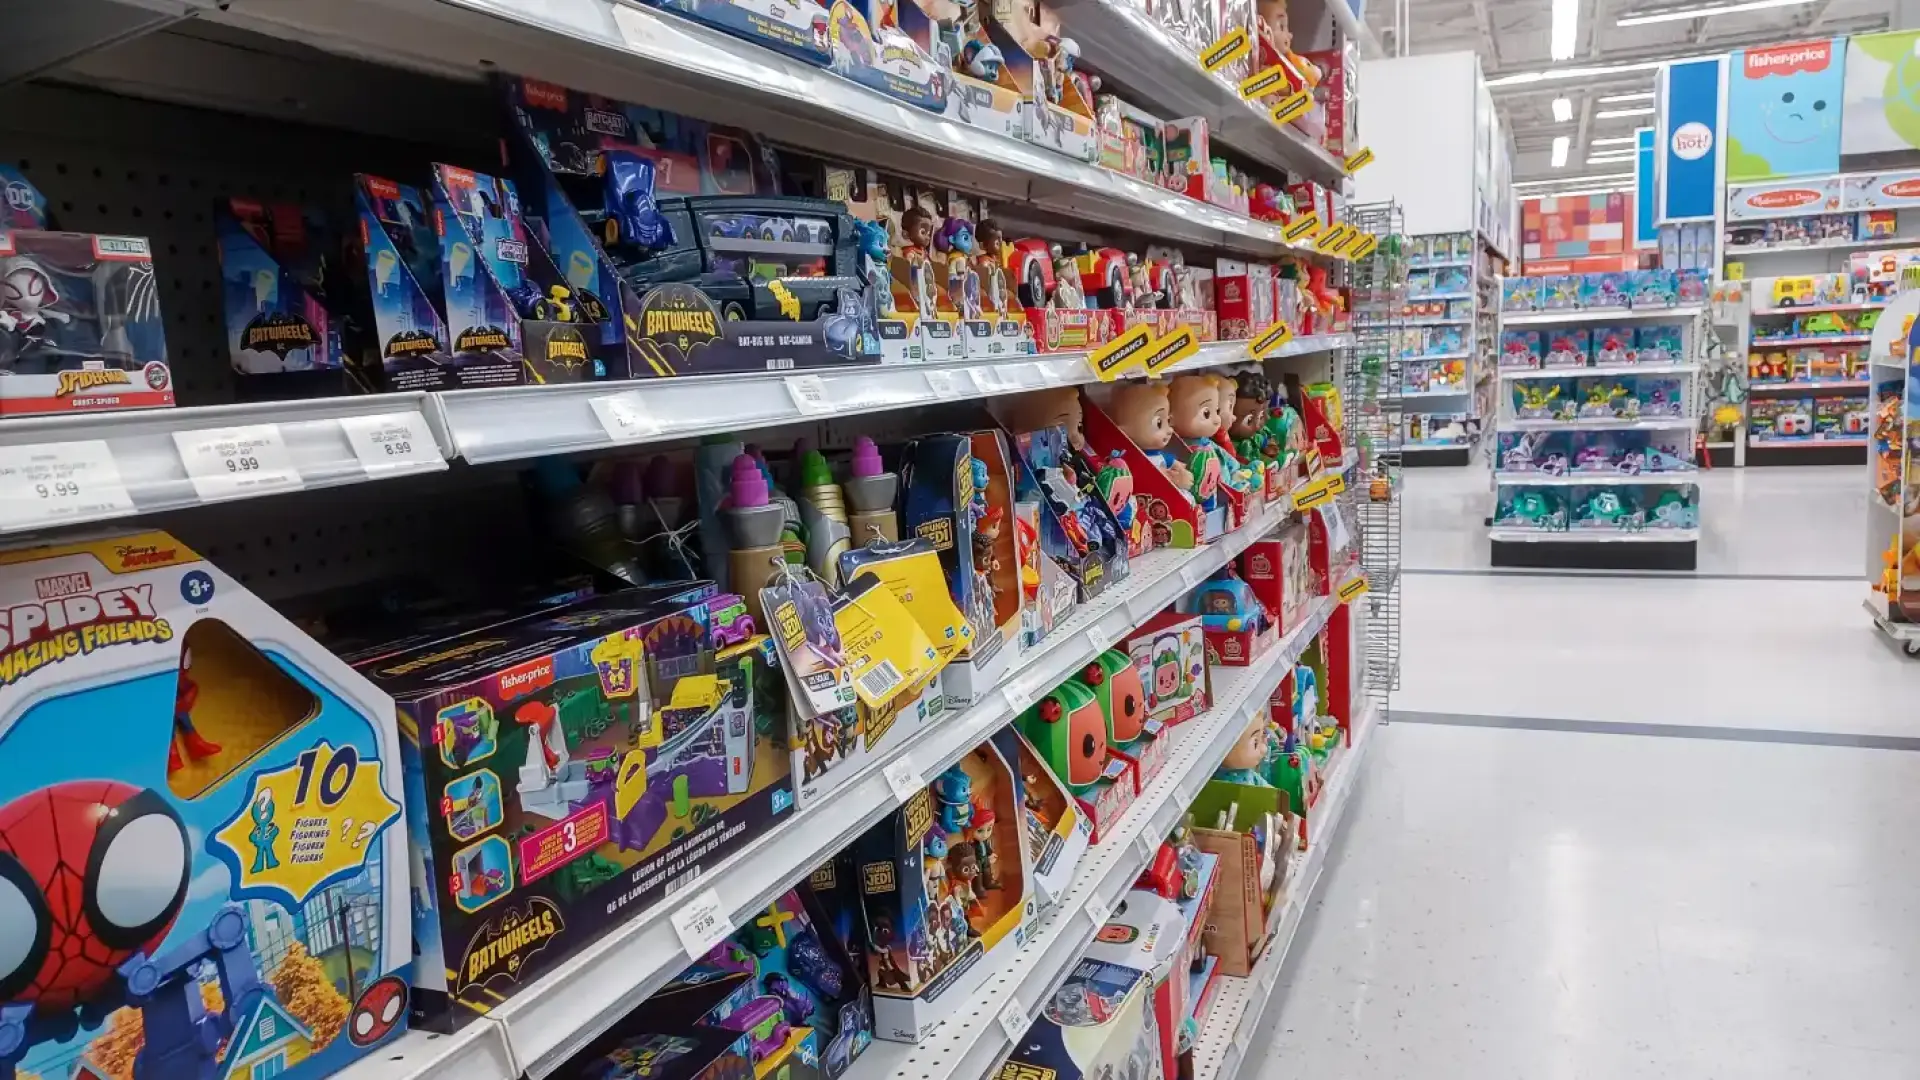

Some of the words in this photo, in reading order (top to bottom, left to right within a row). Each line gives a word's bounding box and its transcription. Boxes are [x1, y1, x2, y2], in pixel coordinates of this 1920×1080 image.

[1207, 36, 1243, 67] CLEARANCE
[1749, 47, 1826, 69] fisher-price
[7, 188, 33, 205] DC
[647, 310, 716, 336] BATWHEELS
[250, 324, 312, 344] BATWHEELS
[461, 334, 507, 349] BATWHEELS
[390, 338, 436, 354] BATWHEELS
[550, 341, 586, 358] BATWHEELS
[1102, 337, 1145, 369] CLEARANCE
[1150, 338, 1187, 367] CLEARANCE
[57, 370, 132, 397] SPIDER-MAN
[384, 442, 412, 455] 8.99
[226, 457, 259, 473] 9.99
[36, 481, 79, 498] 9.99
[38, 573, 91, 599] MARVEL
[188, 579, 211, 598] 3+
[82, 619, 174, 655] FRIENDS
[501, 664, 551, 690] fisher-price
[947, 695, 972, 705] Disney
[434, 727, 444, 741] 1
[293, 744, 359, 807] 10
[773, 794, 785, 810] 3+
[802, 787, 818, 800] Disney
[443, 798, 452, 812] 2
[295, 817, 328, 828] FIGURES
[290, 829, 331, 840] FIGURINES
[563, 821, 577, 853] 3
[292, 841, 325, 851] FIGUREN
[632, 861, 656, 883] LEGION
[656, 855, 665, 867] OF
[683, 825, 717, 850] LAUNCHING
[629, 869, 667, 901] LANCEMENT
[667, 864, 677, 877] DE
[677, 860, 686, 872] LA
[707, 840, 720, 855] DES
[865, 864, 891, 875] YOUNG
[452, 876, 461, 891] 3
[867, 872, 893, 886] JEDI
[468, 910, 555, 983] BATWHEELS
[508, 954, 520, 973] DC
[892, 1028, 917, 1041] Disney
